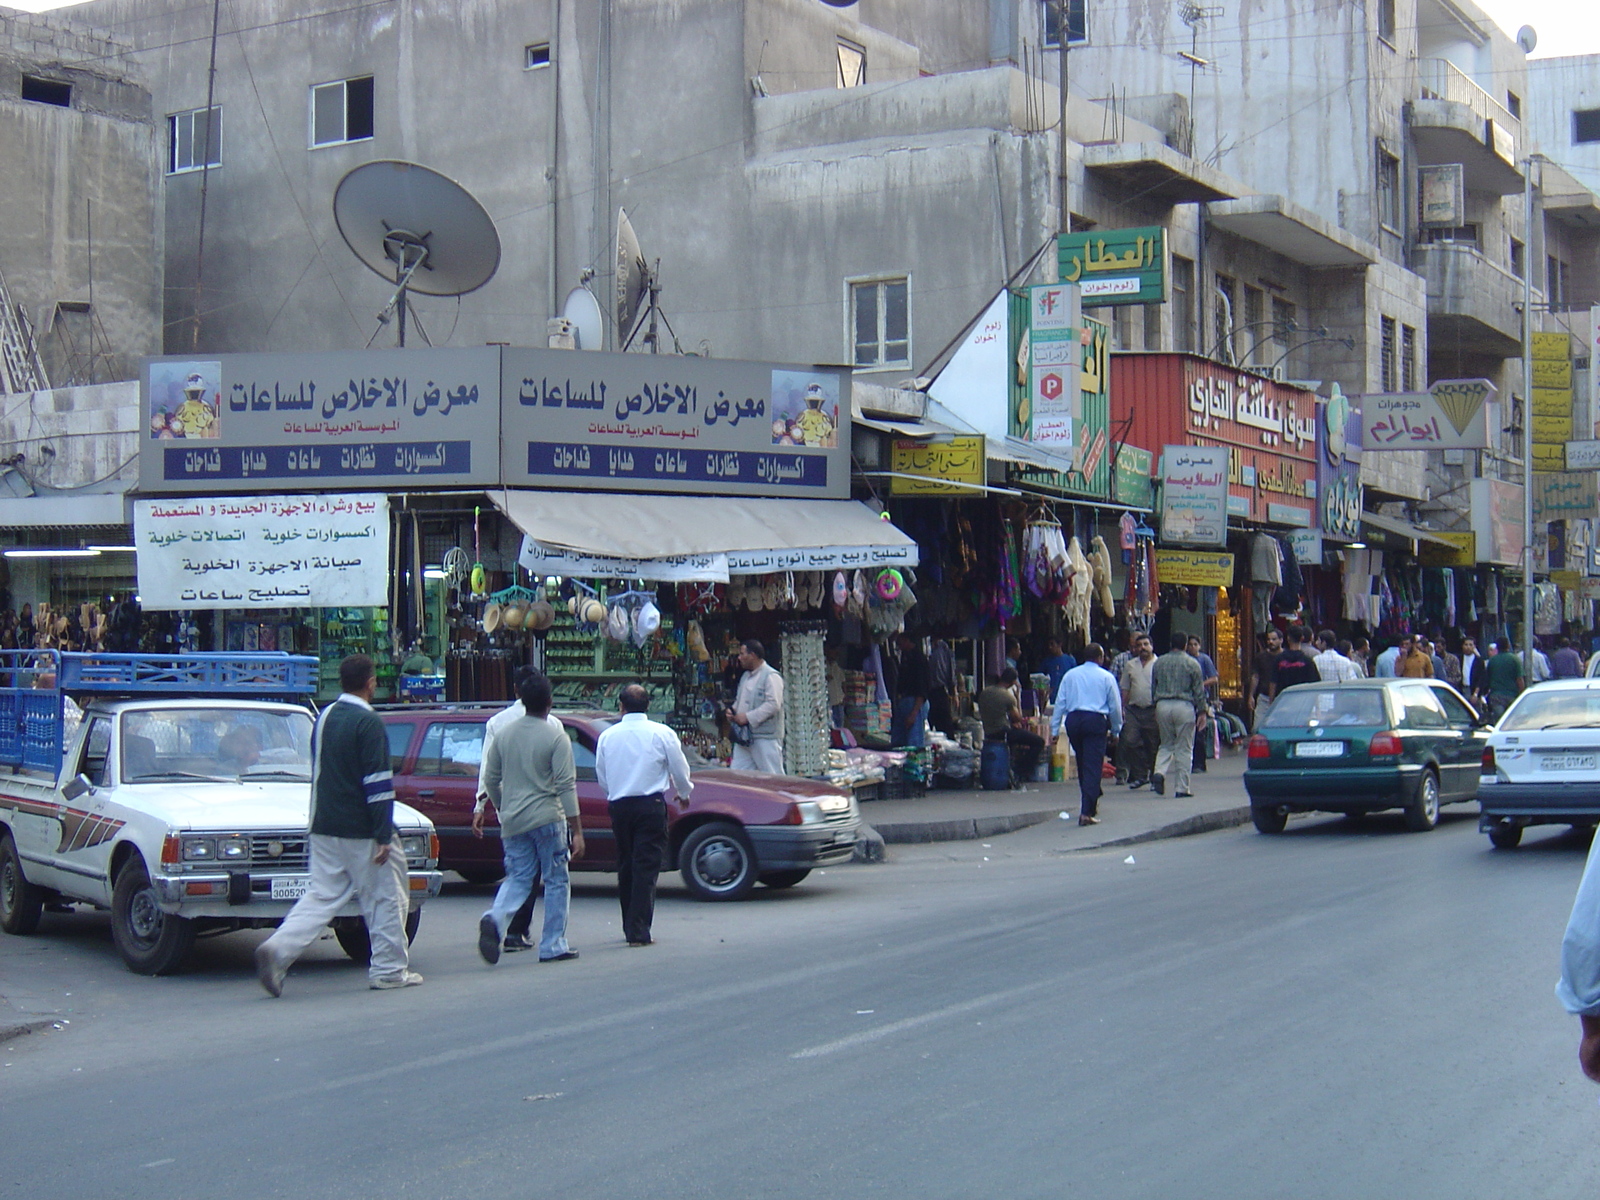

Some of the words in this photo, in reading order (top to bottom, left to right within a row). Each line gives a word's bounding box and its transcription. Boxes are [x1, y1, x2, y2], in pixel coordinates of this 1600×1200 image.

[1065, 235, 1154, 282] العطار
[229, 379, 316, 411] للساعات
[322, 377, 407, 419] الاخلاص
[413, 380, 479, 416] معرض
[519, 377, 607, 410] للساعات
[615, 382, 697, 420] الاخلاص
[704, 391, 765, 426] معرض
[1190, 376, 1233, 430] التجاري
[1378, 400, 1421, 411] مجوهرات
[283, 422, 322, 433] للساعات
[323, 422, 357, 436] العربية
[588, 423, 625, 434] للساعات
[1284, 400, 1316, 450] سوق
[184, 448, 221, 472] قداحات
[241, 450, 267, 476] هدايا
[287, 448, 320, 471] ساعات
[341, 444, 375, 470] نظارات
[395, 443, 446, 473] اكسسوارات
[553, 445, 591, 470] قداحات
[608, 448, 634, 475] هدايا
[654, 449, 687, 474] ساعات
[706, 452, 740, 476] نظارات
[1176, 454, 1213, 466] معرض
[757, 455, 804, 484] اكسسوارات
[1544, 479, 1582, 493] معرض
[151, 505, 204, 518] المستعملة
[220, 502, 267, 519] الجديدة
[271, 501, 316, 517] الاجهزة
[319, 498, 353, 516] وشراء
[355, 501, 376, 515] بيع
[149, 530, 187, 547] خلوية
[191, 529, 246, 543] اتصالات
[263, 528, 302, 546] خلوية
[306, 525, 376, 540] اكسسوارات
[728, 557, 774, 569] الساعات
[777, 551, 805, 567] أنواع
[808, 554, 837, 565] جميع
[872, 548, 907, 561] تصليح
[182, 559, 240, 575] الخلوية
[248, 560, 308, 575] الاجهزة
[312, 557, 361, 571] صيانة
[591, 565, 612, 574] ساعات
[615, 565, 637, 576] تصليح
[180, 589, 243, 601] ساعات
[250, 584, 311, 601] تصليح
